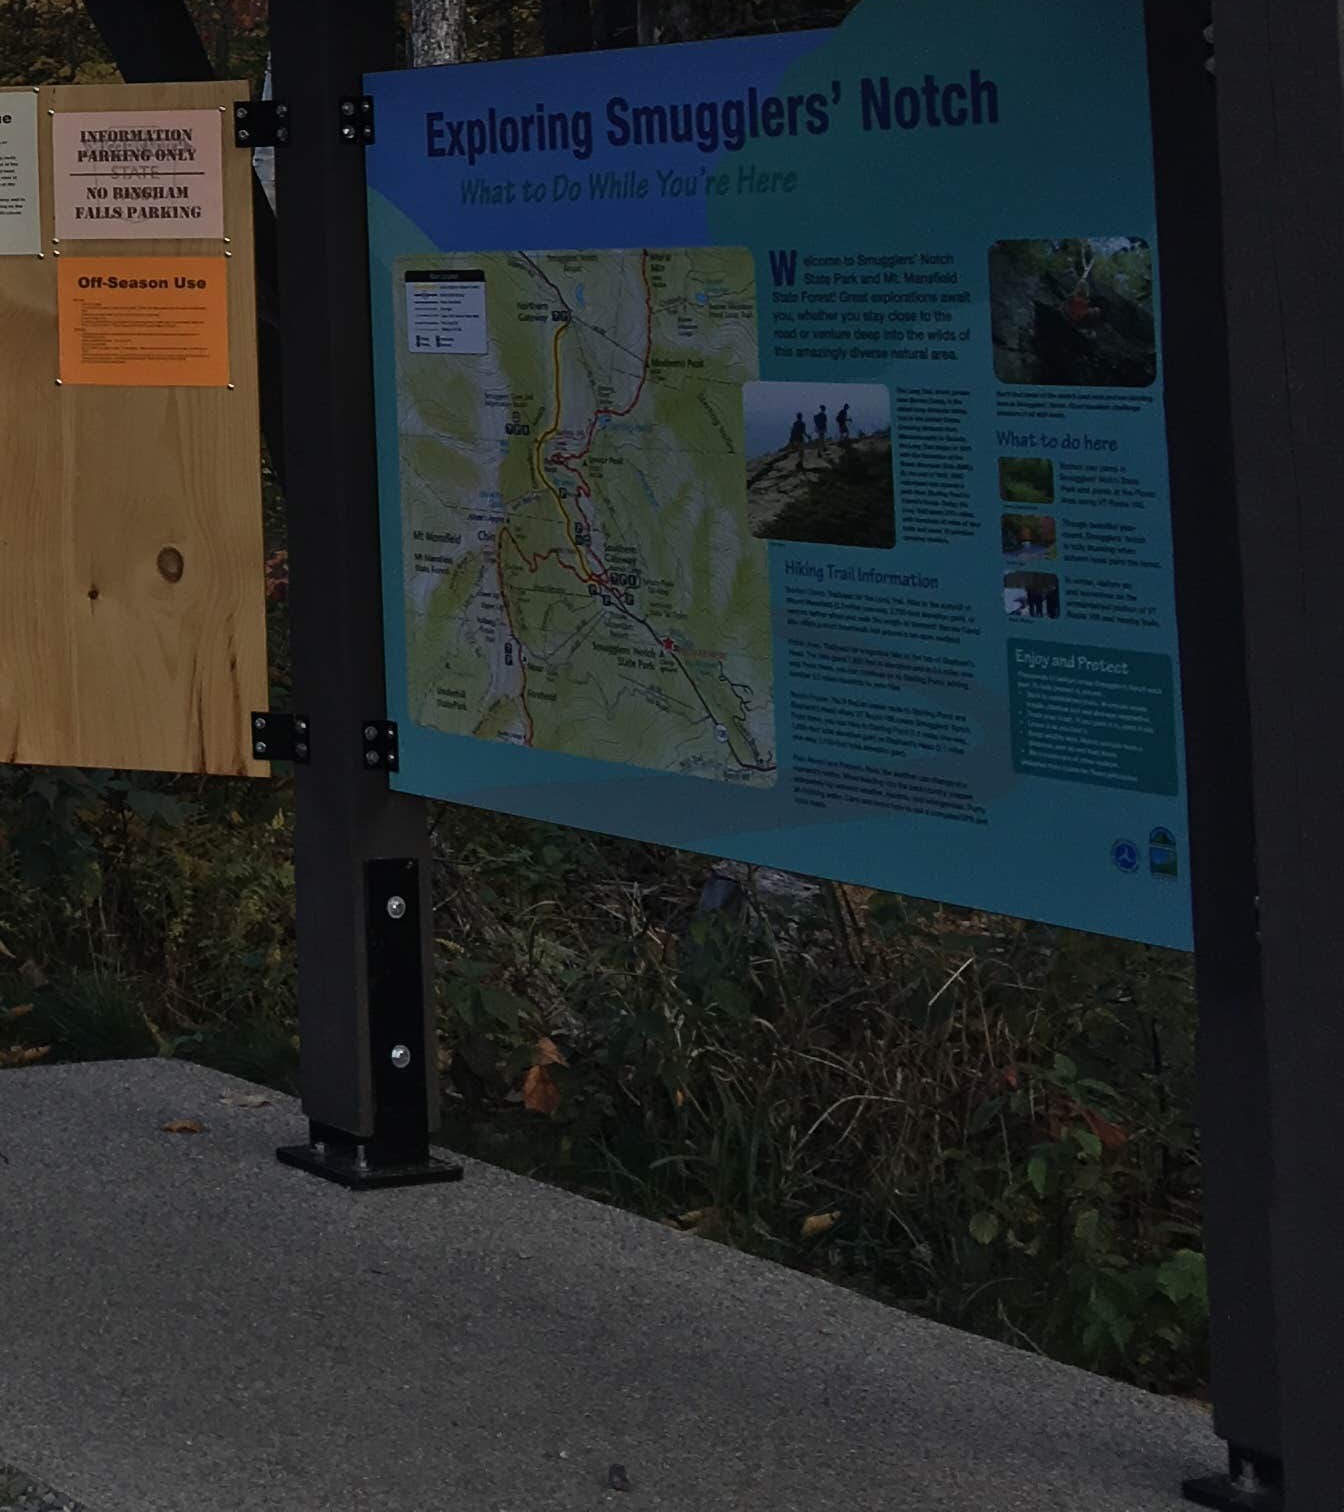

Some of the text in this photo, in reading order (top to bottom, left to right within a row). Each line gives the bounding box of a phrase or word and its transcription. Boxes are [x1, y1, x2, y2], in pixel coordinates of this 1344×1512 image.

[425, 69, 999, 165] Exploring Smugglers' Notch
[80, 129, 193, 143] INFORMATION
[77, 148, 196, 162] PARKING ONLY
[461, 164, 798, 205] What to Do While You're Here
[86, 186, 189, 200] NO BINGHAM
[75, 206, 202, 219] FALLS PARKING
[920, 253, 954, 265] Notch
[78, 276, 207, 289] Off-Season Use
[803, 272, 832, 285] State
[833, 272, 857, 284] Park
[860, 273, 881, 284] and
[904, 272, 958, 284] Mansfield
[772, 291, 798, 303] State
[839, 291, 868, 303] Great
[871, 291, 938, 305] explorations
[797, 309, 838, 321] whether
[840, 312, 861, 324] you
[888, 309, 917, 321] close
[919, 310, 931, 322] to
[934, 310, 952, 322] the
[774, 328, 797, 339] road
[799, 329, 810, 339] or
[883, 329, 905, 340] into
[906, 329, 925, 340] the
[959, 328, 971, 341] of
[796, 347, 848, 360] amazingly
[890, 347, 929, 359] natural
[995, 430, 1119, 452] What to do here
[785, 559, 939, 589] Hiking Trail Information
[1015, 648, 1129, 675] Enjoy and Protect
